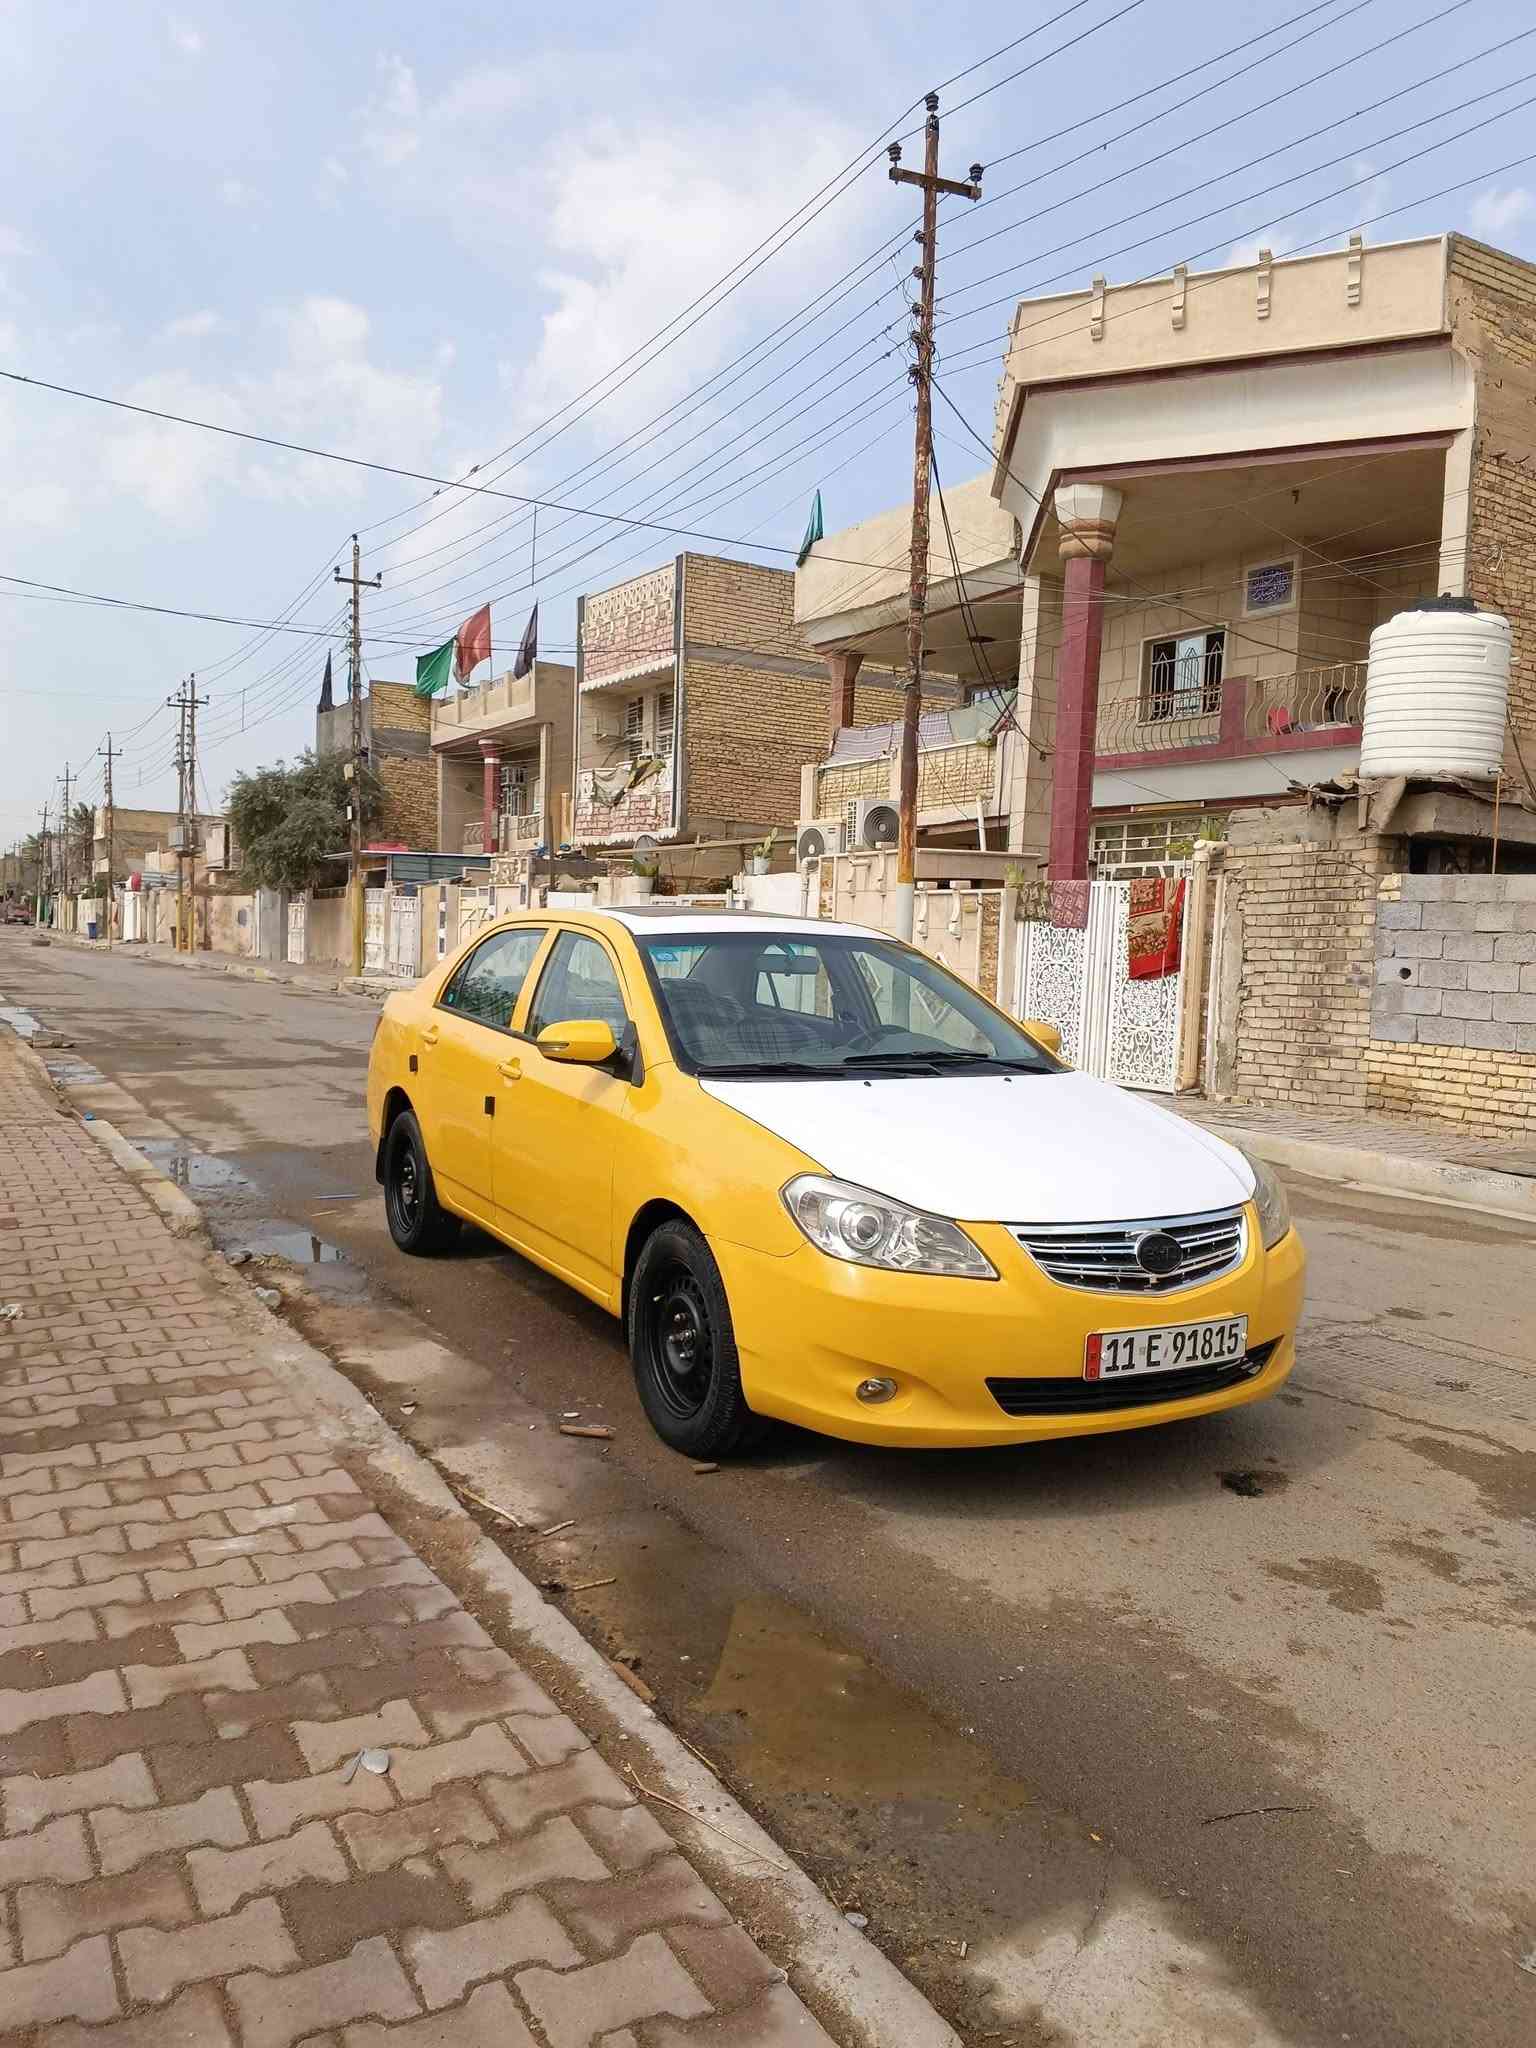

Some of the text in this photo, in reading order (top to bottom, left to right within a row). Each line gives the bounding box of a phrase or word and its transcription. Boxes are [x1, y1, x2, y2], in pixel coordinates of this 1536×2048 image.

[1105, 1337, 1135, 1372] 11
[1146, 1334, 1162, 1367] E
[1172, 1323, 1240, 1364] 91815
